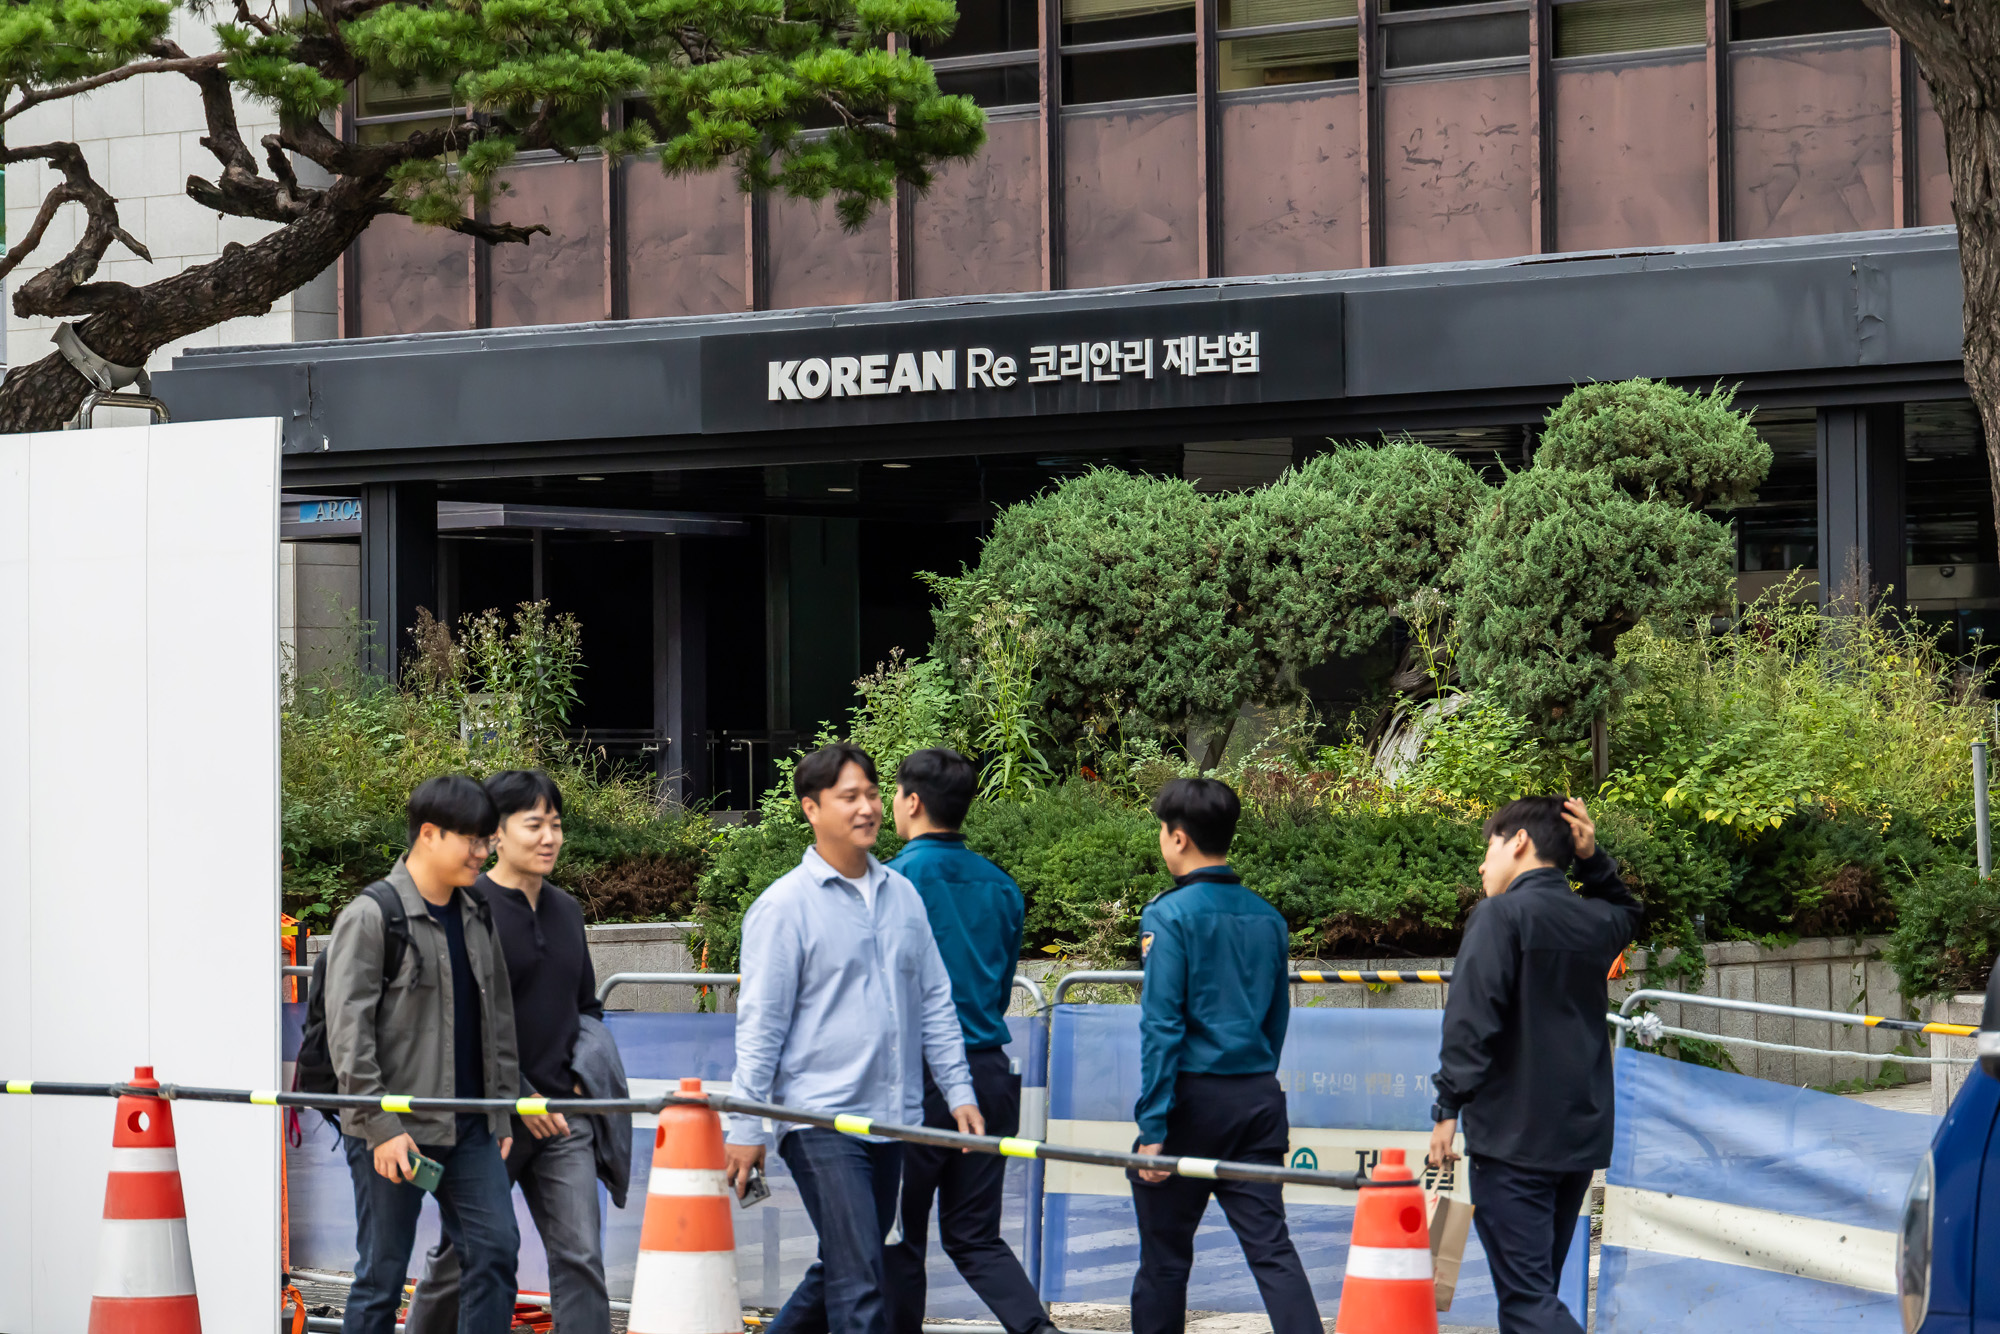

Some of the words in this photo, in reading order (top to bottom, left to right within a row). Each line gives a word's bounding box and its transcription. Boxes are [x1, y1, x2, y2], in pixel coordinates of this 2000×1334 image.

[768, 349, 956, 400] KOREAN
[967, 347, 1018, 388] Re
[1028, 338, 1153, 383] 코리안리
[1162, 331, 1260, 376] 재보험
[1312, 1072, 1357, 1096] 당신의
